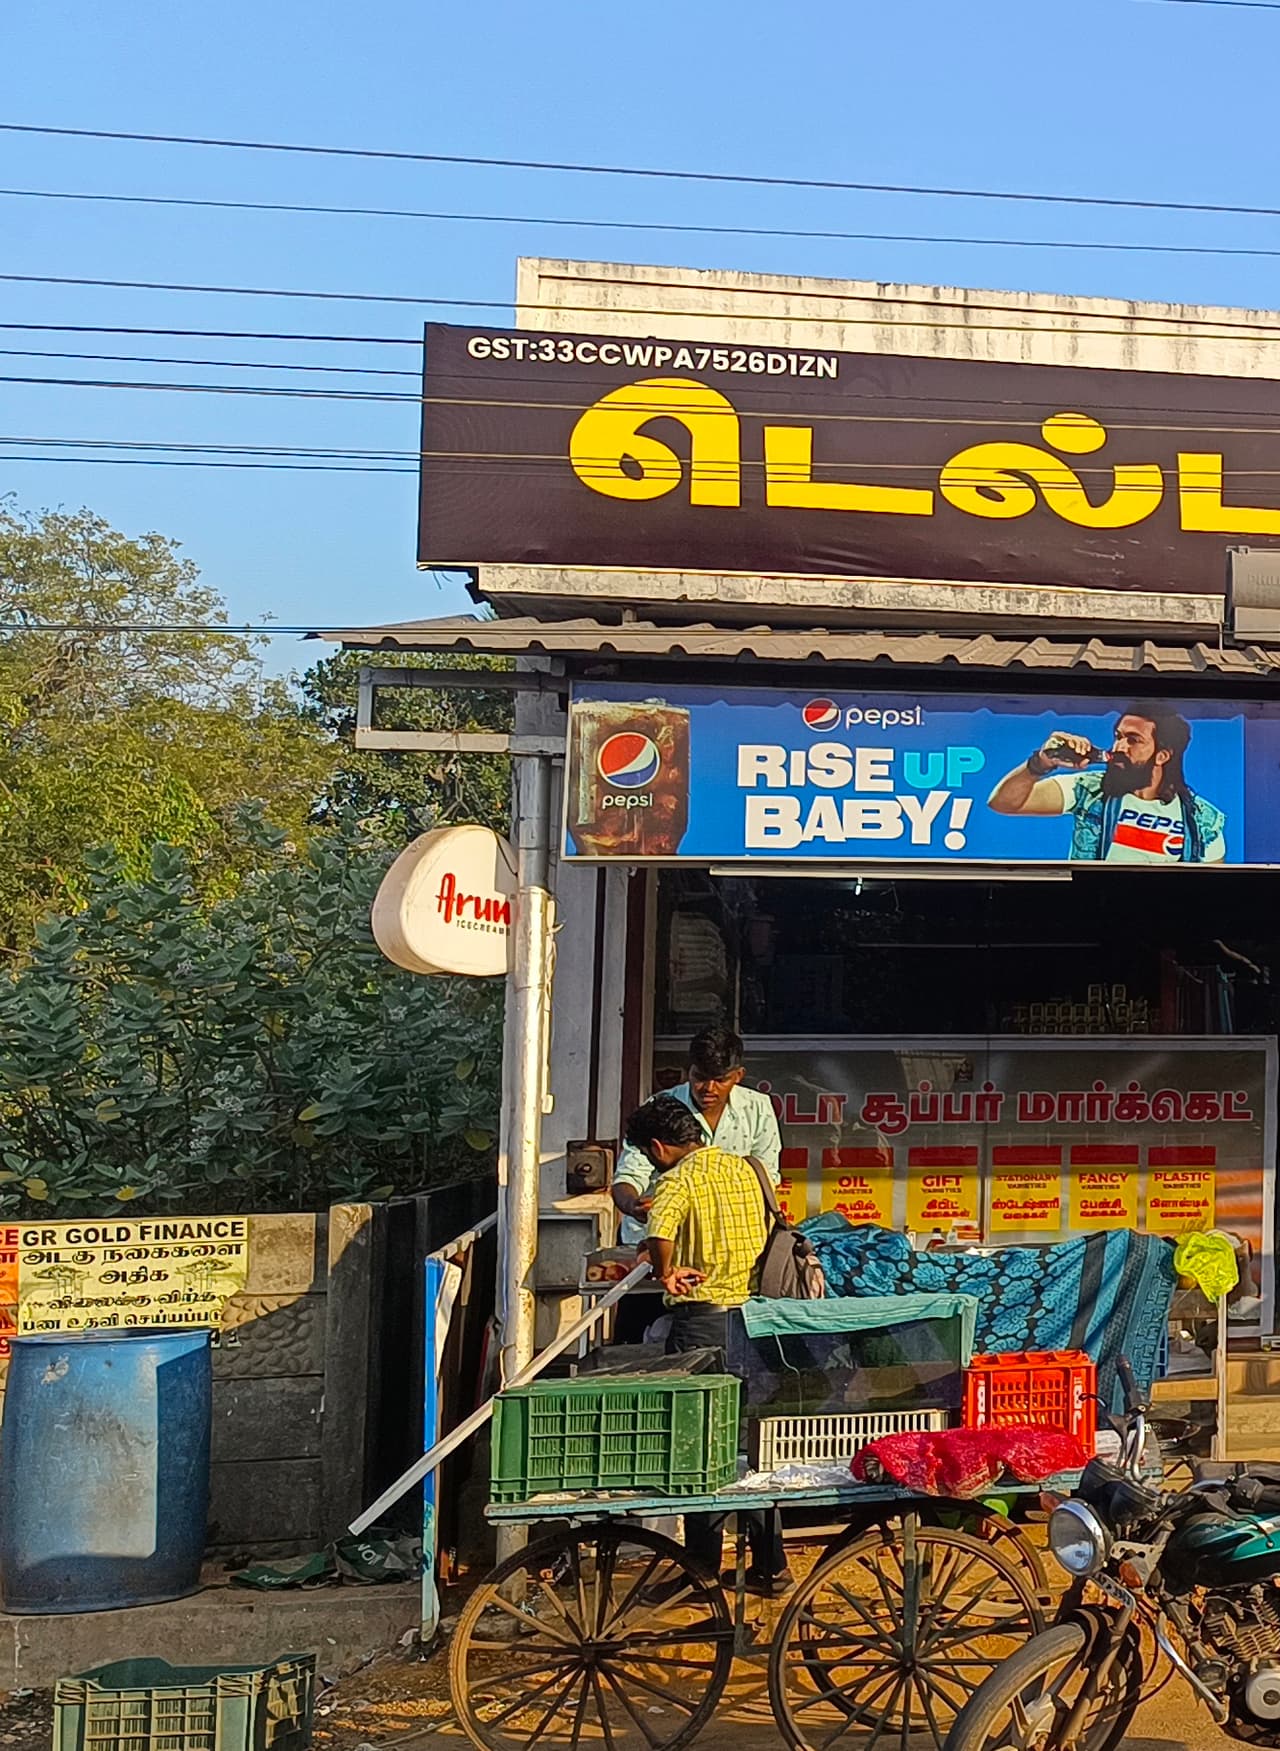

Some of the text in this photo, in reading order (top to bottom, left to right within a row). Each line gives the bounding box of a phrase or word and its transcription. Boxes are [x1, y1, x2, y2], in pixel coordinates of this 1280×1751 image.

[467, 336, 838, 378] GST:33CCWPA7526D1ZN
[845, 703, 922, 730] pepsi
[736, 742, 985, 792] RISE UP
[600, 791, 653, 811] pepsi
[744, 790, 973, 852] BABY!
[1119, 808, 1185, 835] PEPS
[435, 873, 511, 925] Arun
[862, 1081, 1005, 1134] சூப்பர்
[1016, 1080, 1254, 1123] மார்க்கெட்
[838, 1175, 869, 1188] OIL
[922, 1175, 964, 1188] GIFT
[1078, 1172, 1129, 1183] FANCY
[1154, 1172, 1212, 1182] PLASTIC
[23, 1229, 57, 1246] GR
[65, 1227, 130, 1244] GOLD
[140, 1222, 244, 1240] FINANCE
[22, 1249, 96, 1265] அடகு
[98, 1266, 170, 1286] அதிக
[22, 1319, 60, 1332] பண
[66, 1313, 120, 1330] உதவி
